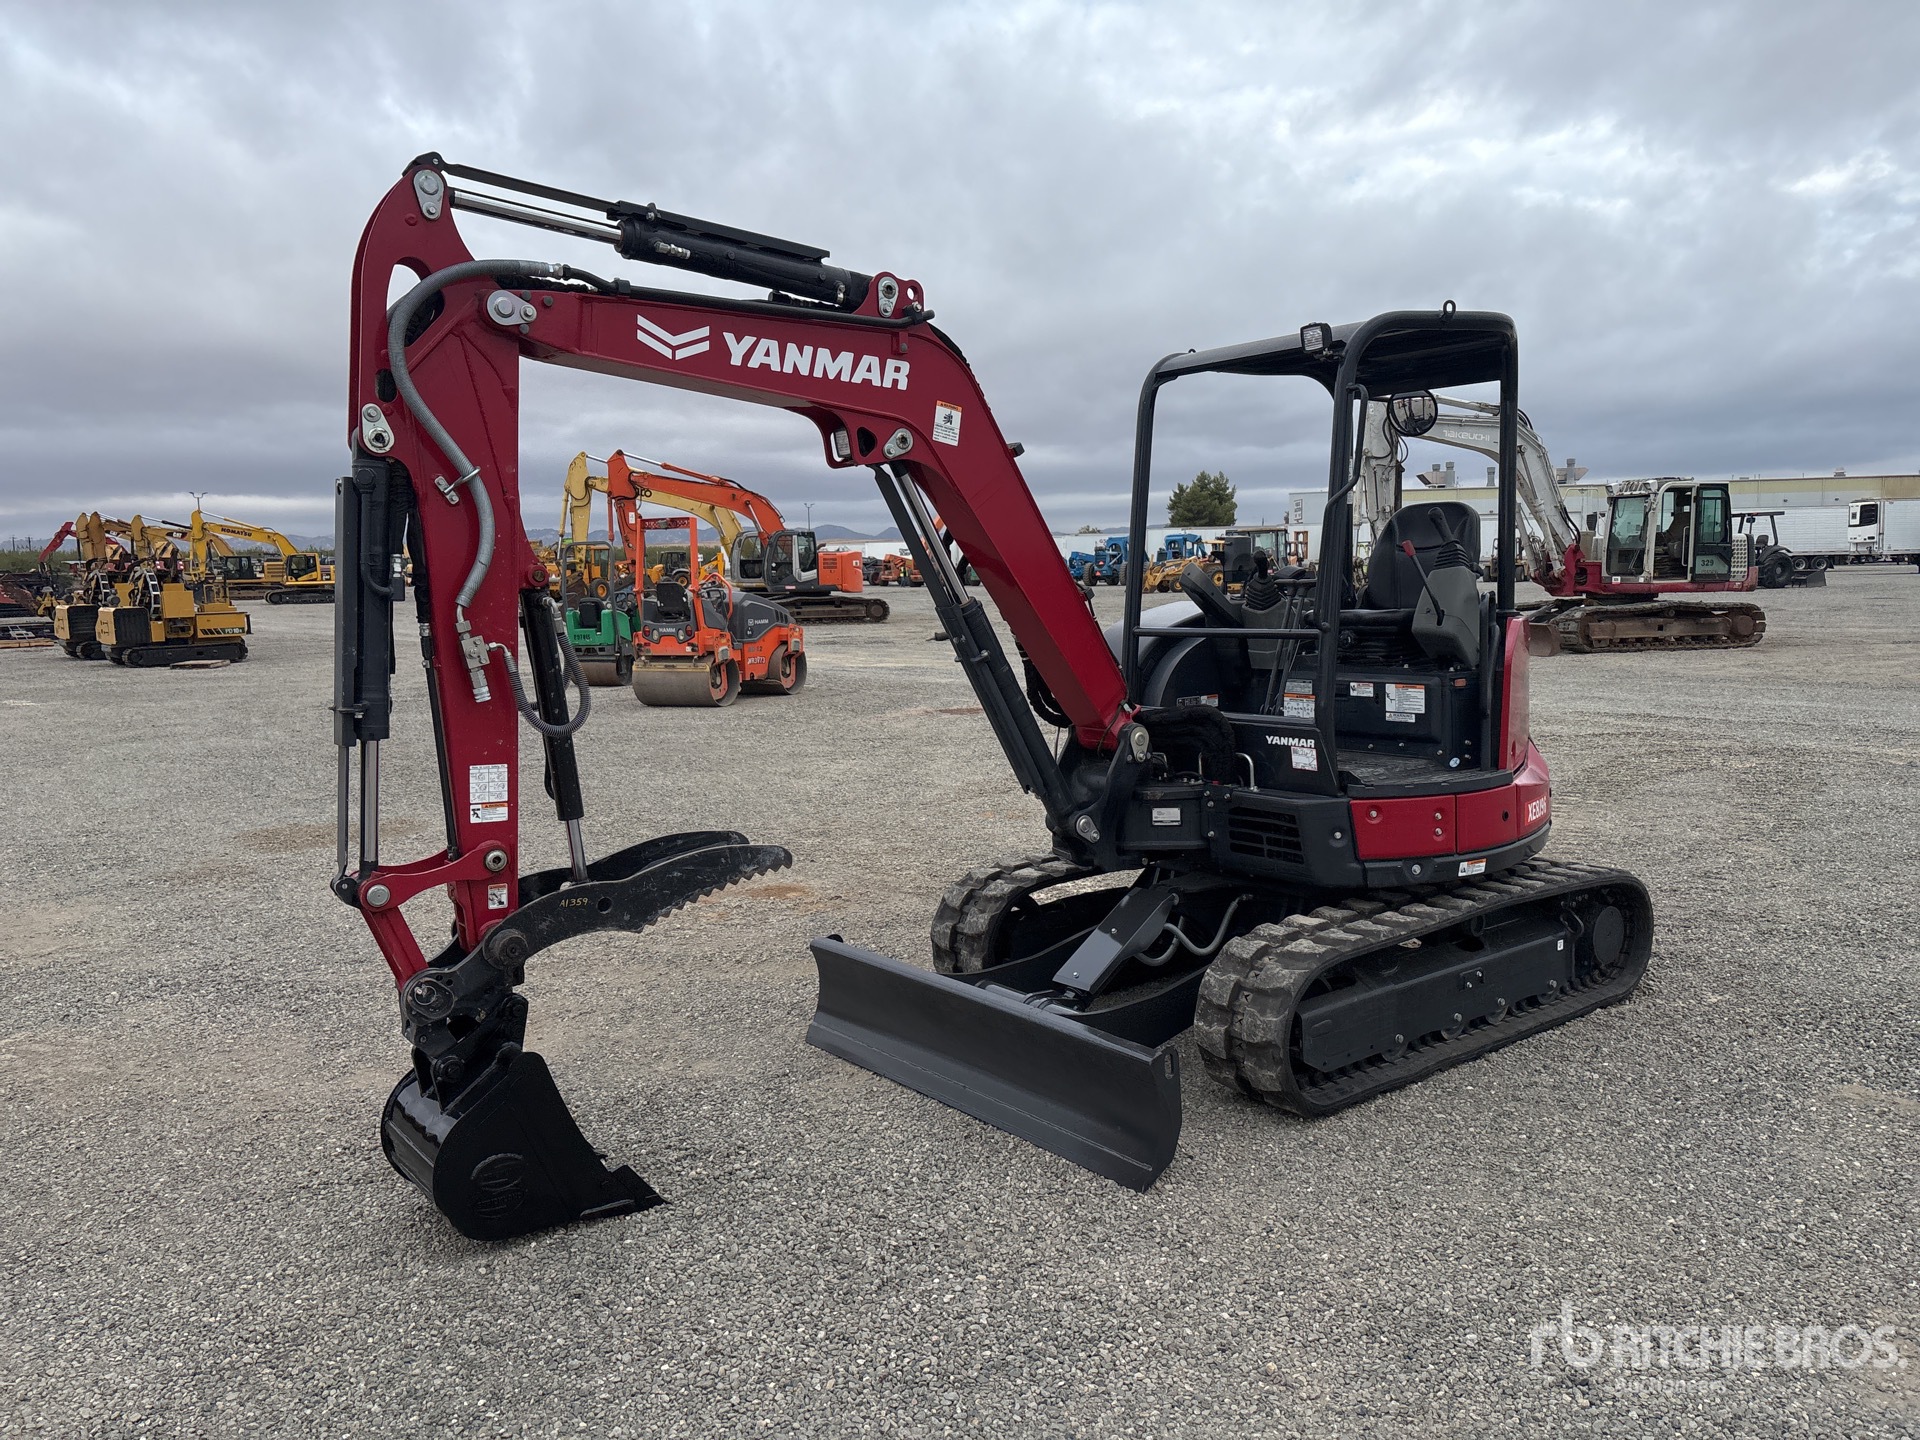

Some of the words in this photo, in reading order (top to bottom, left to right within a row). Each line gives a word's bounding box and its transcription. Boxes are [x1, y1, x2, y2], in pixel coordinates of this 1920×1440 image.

[722, 331, 911, 391] YANMAR
[221, 527, 252, 537] KOMATSU
[1701, 559, 1714, 567] 329
[1265, 735, 1315, 748] YANMAR
